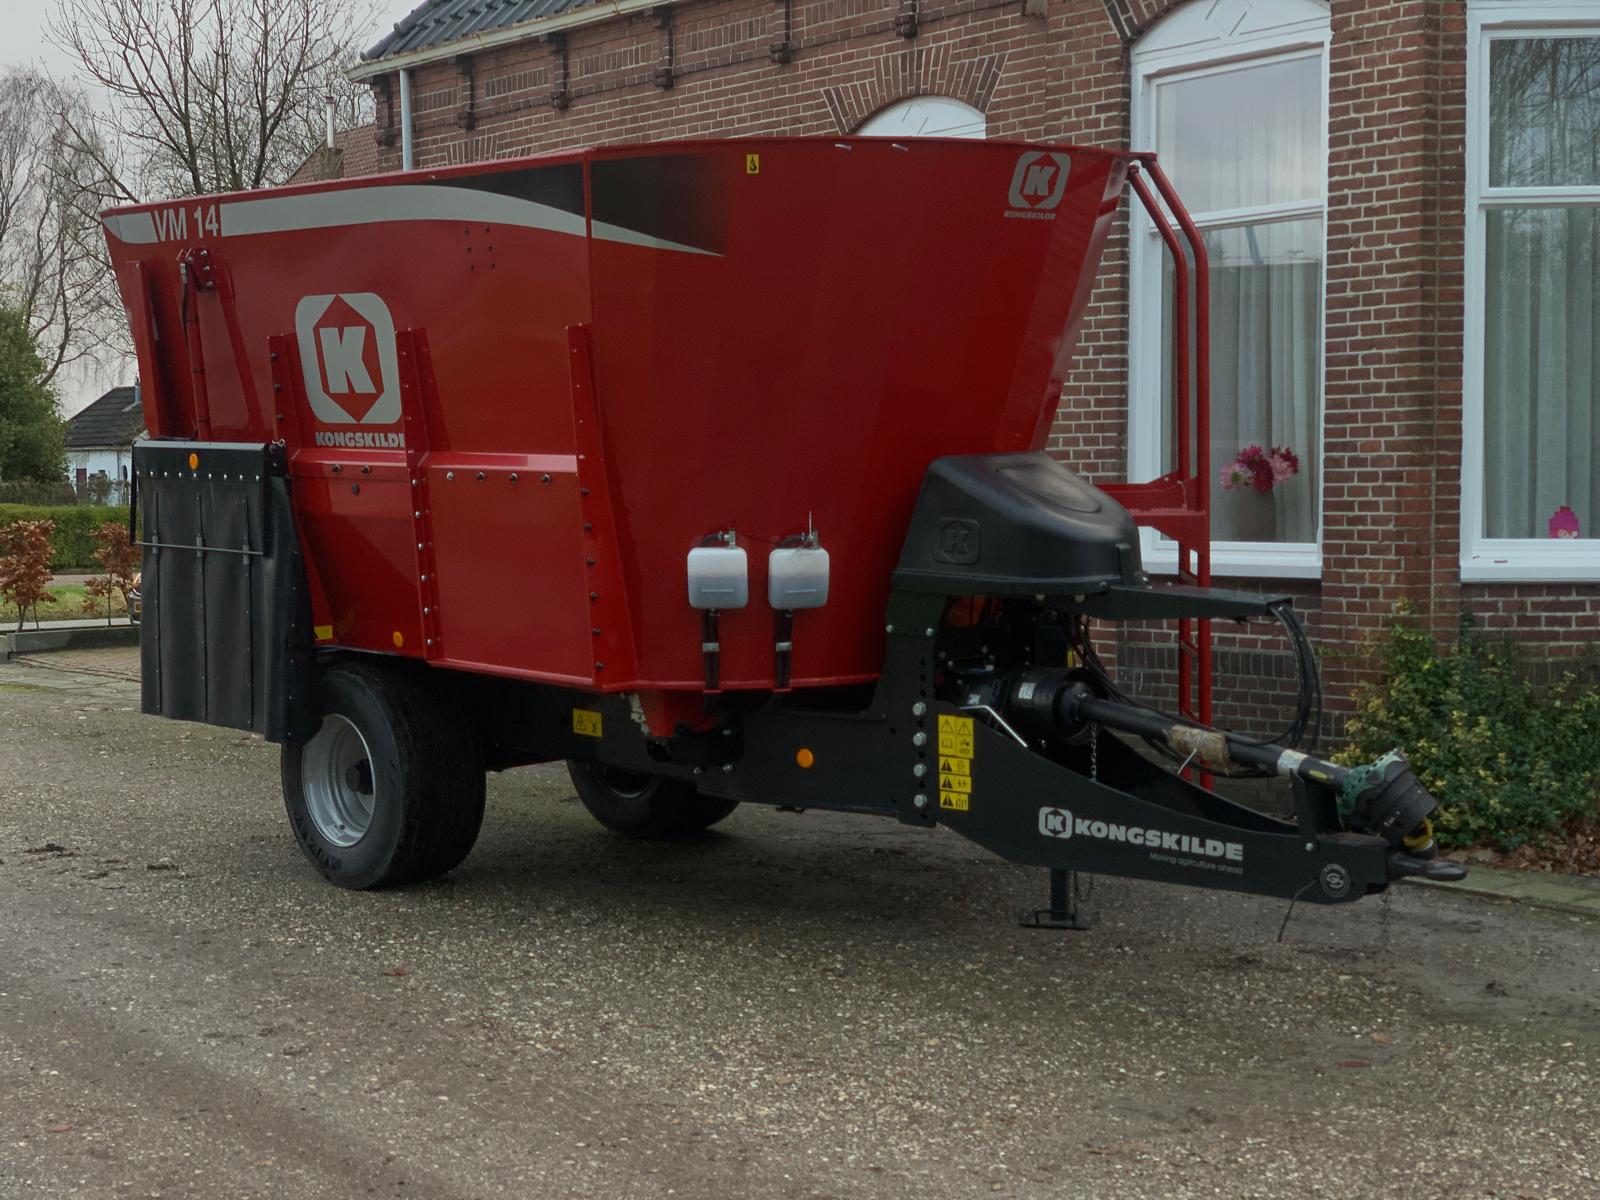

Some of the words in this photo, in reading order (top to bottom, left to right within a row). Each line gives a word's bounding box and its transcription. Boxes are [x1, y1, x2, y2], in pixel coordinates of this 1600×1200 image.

[1023, 165, 1057, 195] K
[154, 208, 187, 241] VM
[194, 204, 218, 238] 14
[319, 326, 377, 394] K
[1047, 814, 1064, 831] K
[1075, 817, 1243, 861] KONGSKILDE
[1217, 864, 1243, 874] ahead
